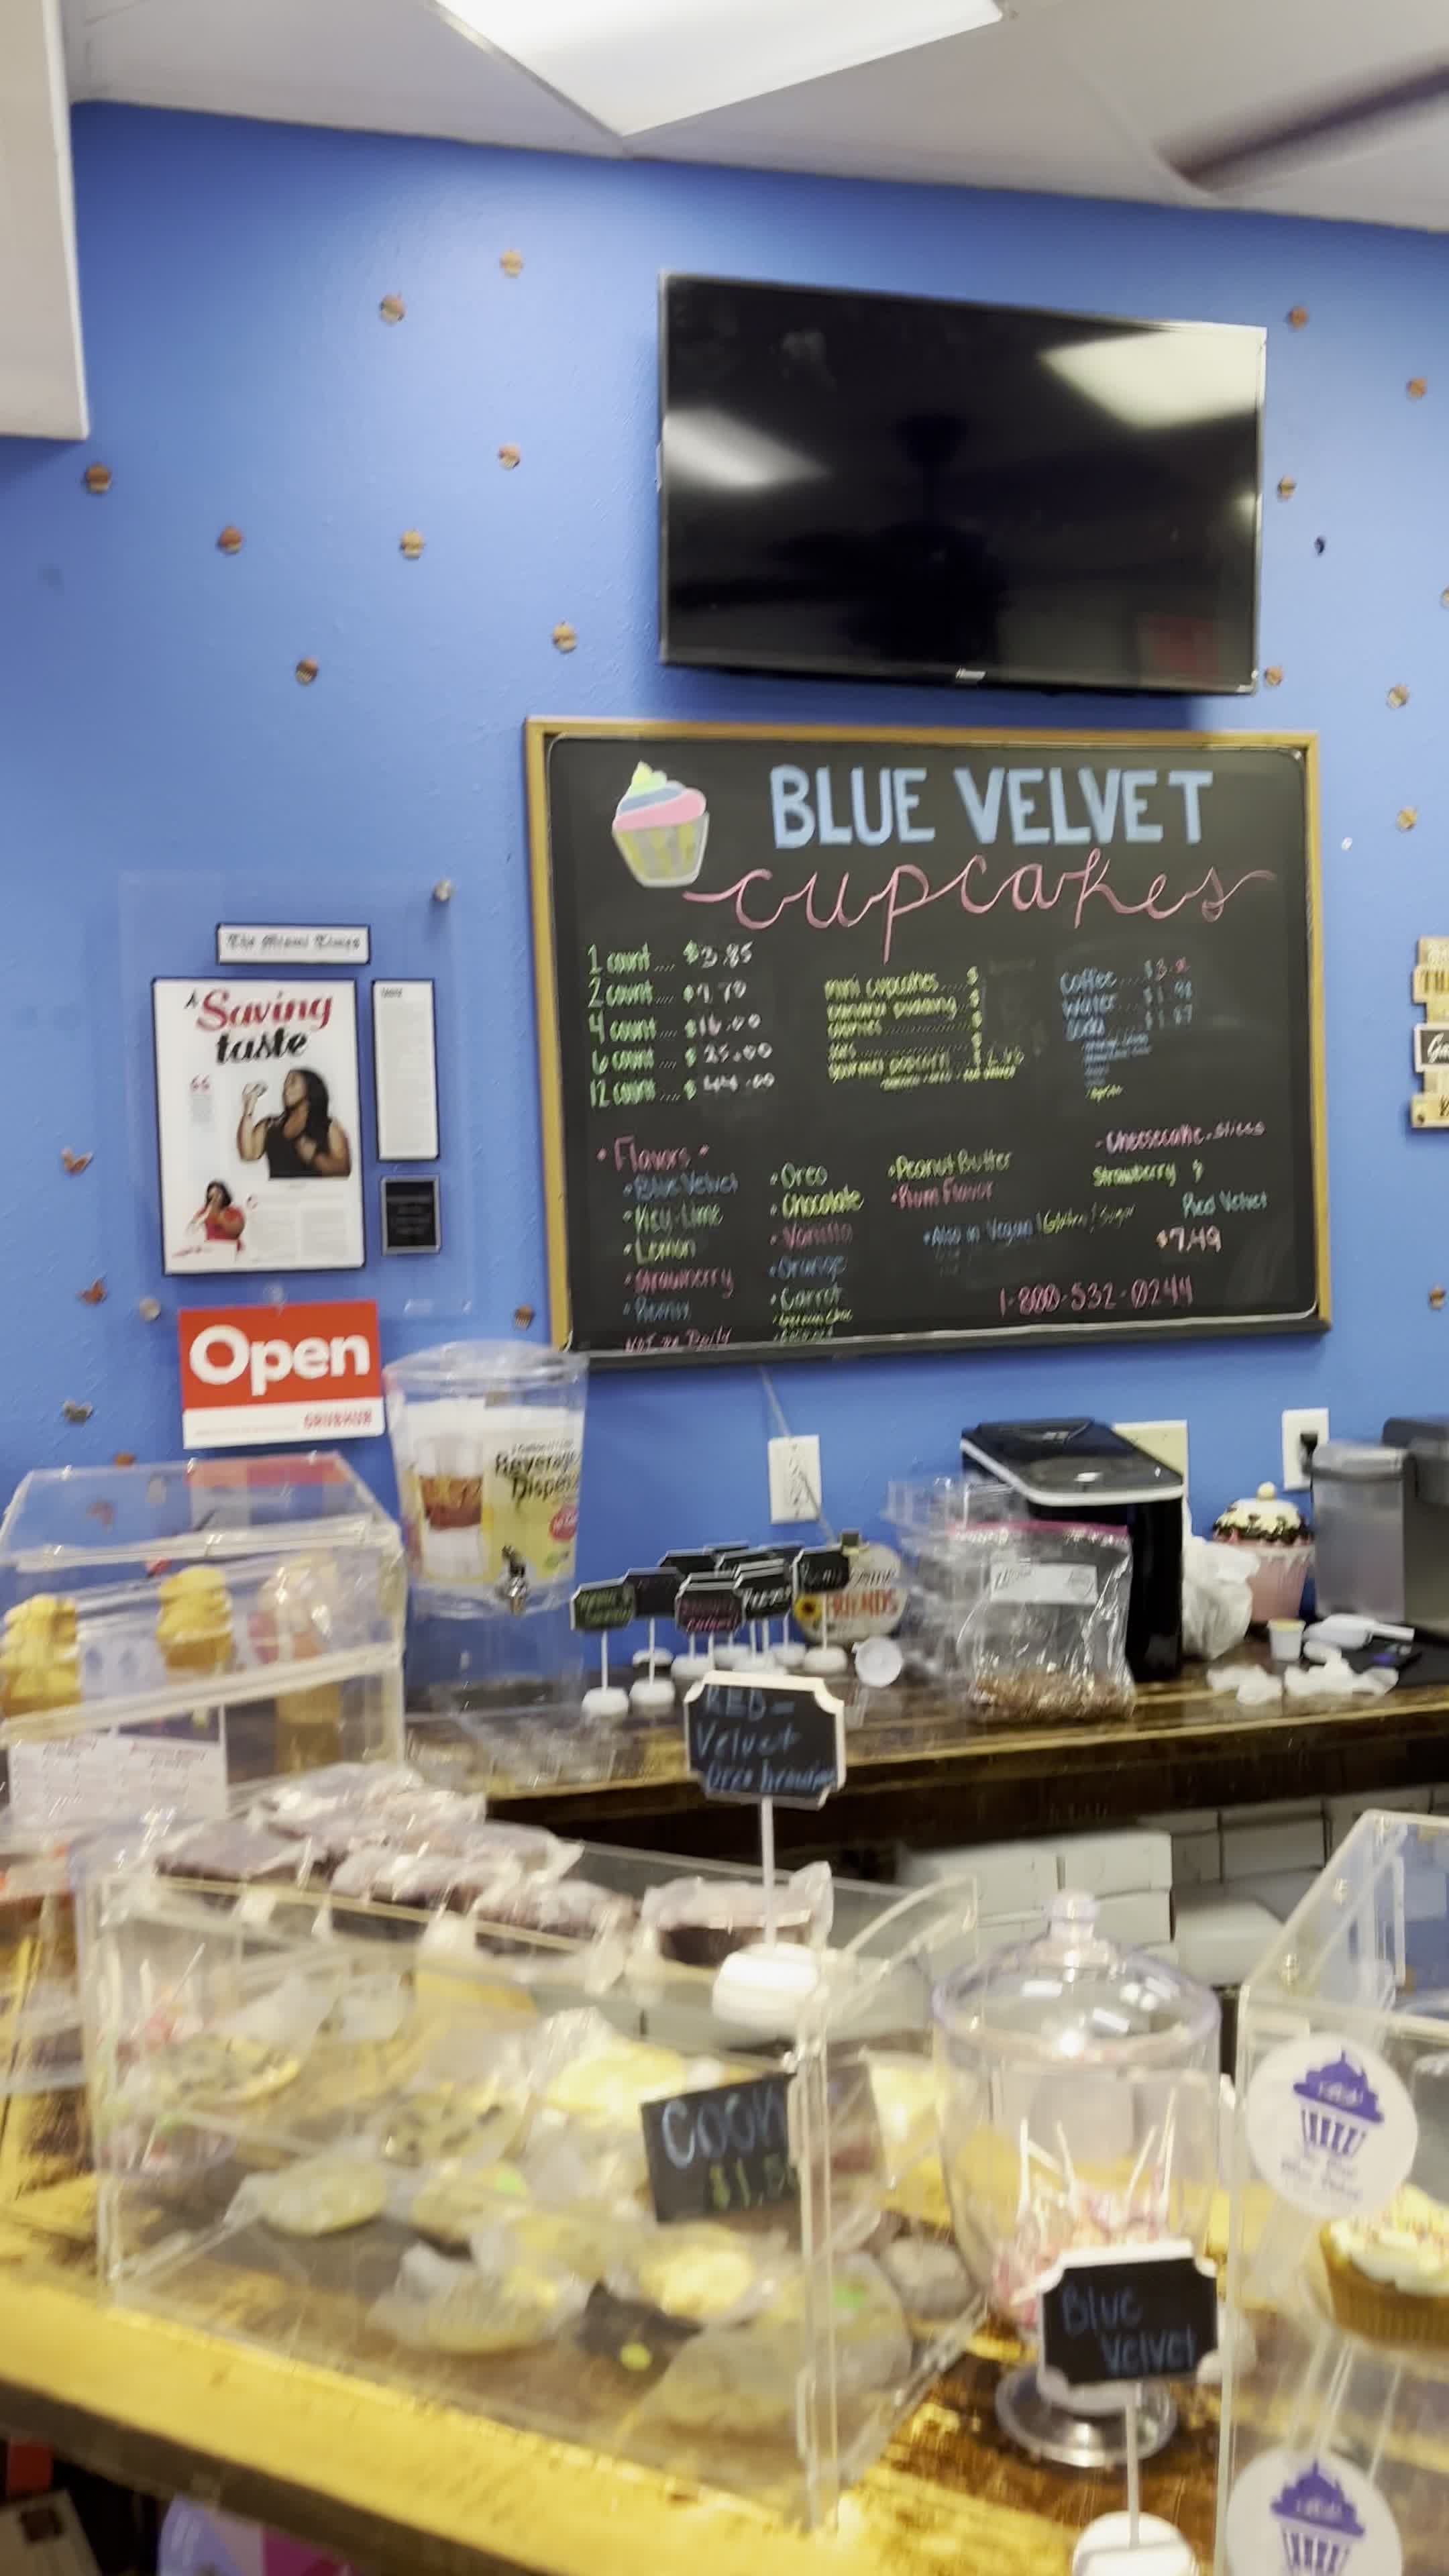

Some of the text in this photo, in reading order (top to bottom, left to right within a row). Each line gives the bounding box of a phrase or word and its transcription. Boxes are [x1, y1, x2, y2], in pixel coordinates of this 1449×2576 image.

[769, 765, 1213, 849] BLUE VELVET
[683, 847, 1275, 964] cupcakes
[588, 945, 602, 973] 1
[606, 941, 651, 973] count
[588, 977, 603, 1008] 2
[606, 979, 653, 1006] count
[195, 987, 333, 1032] Saving
[589, 1010, 604, 1043] 4
[610, 1017, 655, 1040] count
[215, 1026, 309, 1065] taste
[612, 1046, 654, 1071] count
[590, 1079, 610, 1107] 12
[613, 1080, 655, 1104] count
[781, 1163, 828, 1189] Oreo
[896, 1148, 1014, 1181] Peanut Butter
[782, 1185, 864, 1219] Chocolate
[782, 1222, 853, 1249] Vanilla
[635, 1240, 696, 1265] Lemon
[189, 1324, 371, 1396] Open
